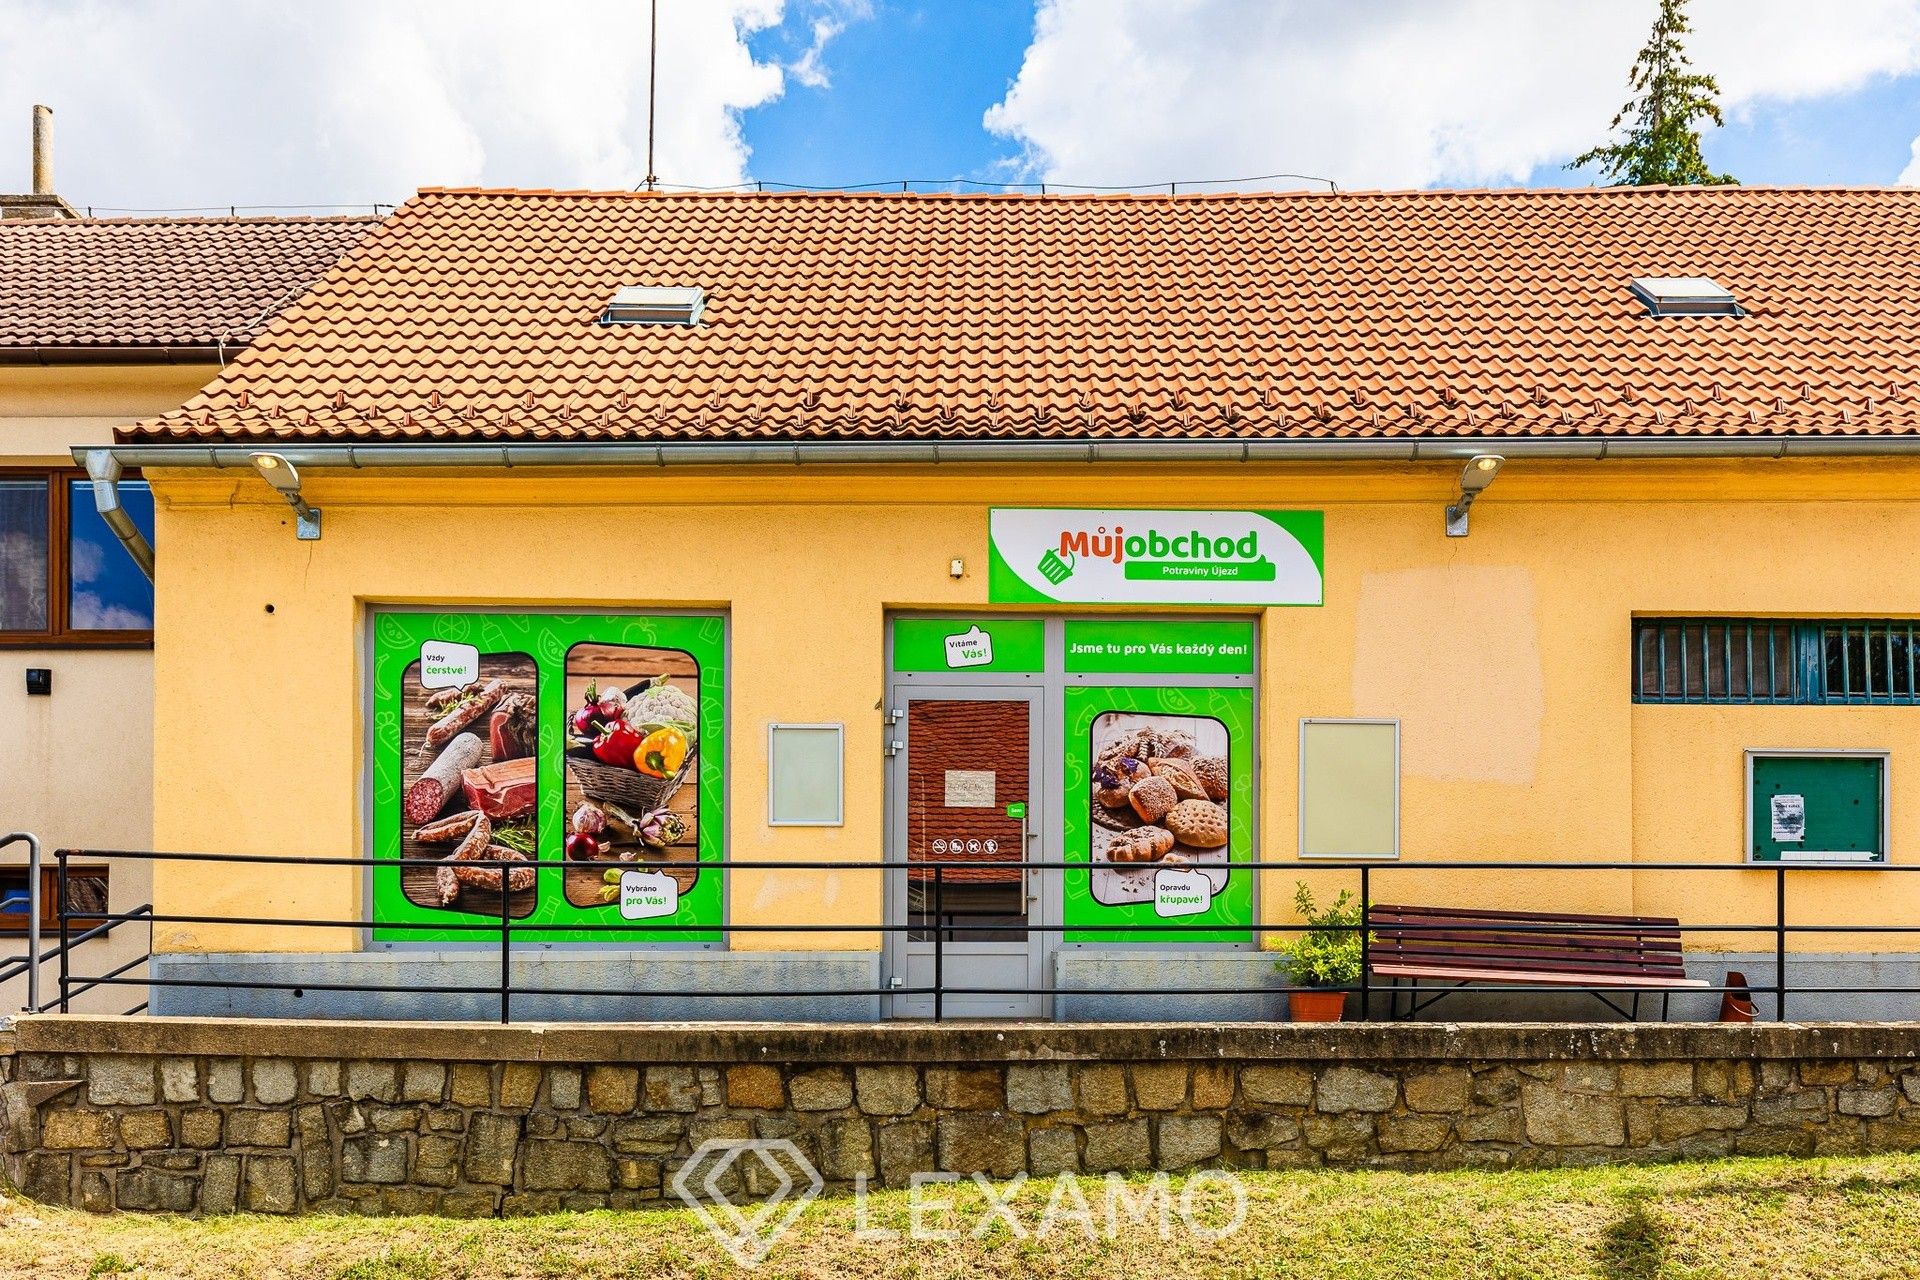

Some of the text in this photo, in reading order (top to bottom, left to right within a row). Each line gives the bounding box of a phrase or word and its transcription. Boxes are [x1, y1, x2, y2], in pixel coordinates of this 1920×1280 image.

[1162, 565, 1239, 577] Potraviny Újezd
[949, 640, 978, 648] Vítáme
[962, 648, 987, 659] Vás!
[1070, 643, 1248, 657] Jsme tu pro Vás každý den!
[426, 665, 467, 675] čerstvé!
[626, 885, 657, 893] Vybráno
[626, 895, 667, 907] pro Vás!
[1160, 894, 1203, 905] křupavé!
